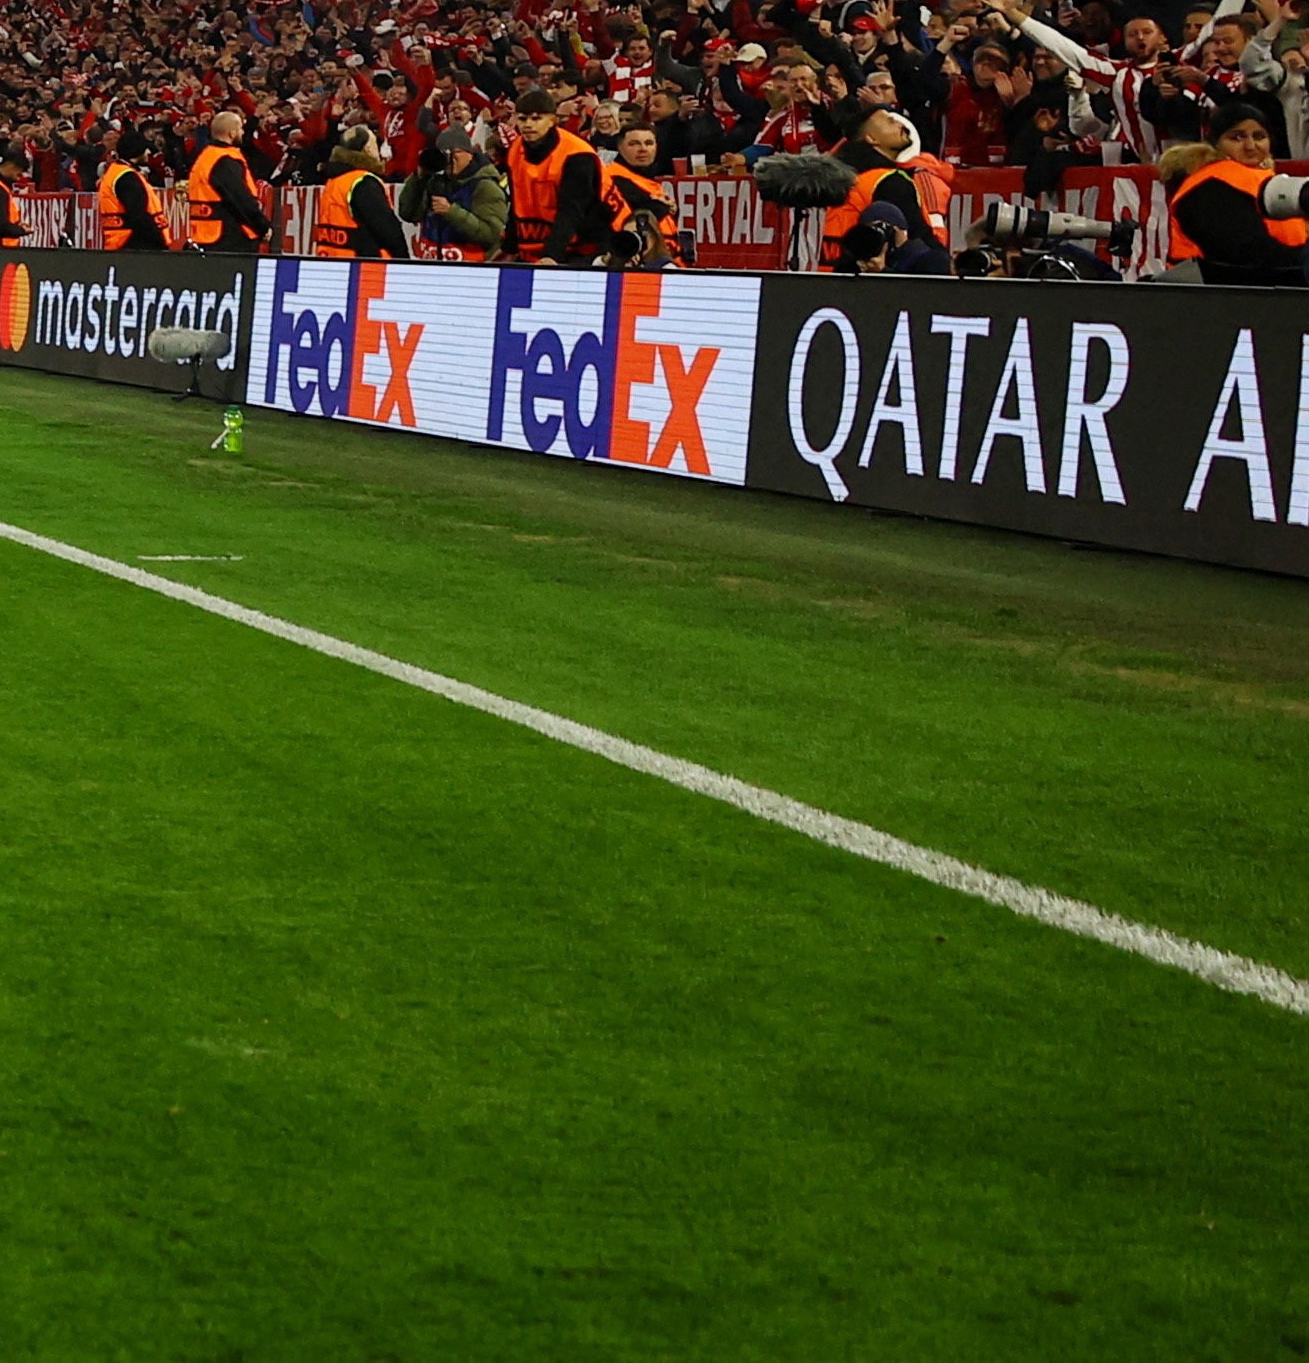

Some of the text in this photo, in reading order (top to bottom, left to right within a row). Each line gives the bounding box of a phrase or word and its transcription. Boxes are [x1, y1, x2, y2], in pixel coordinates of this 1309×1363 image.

[34, 265, 245, 372] mastercard
[265, 259, 426, 429] FedEx
[486, 266, 722, 477] FedEx
[786, 306, 1128, 504] QATAR
